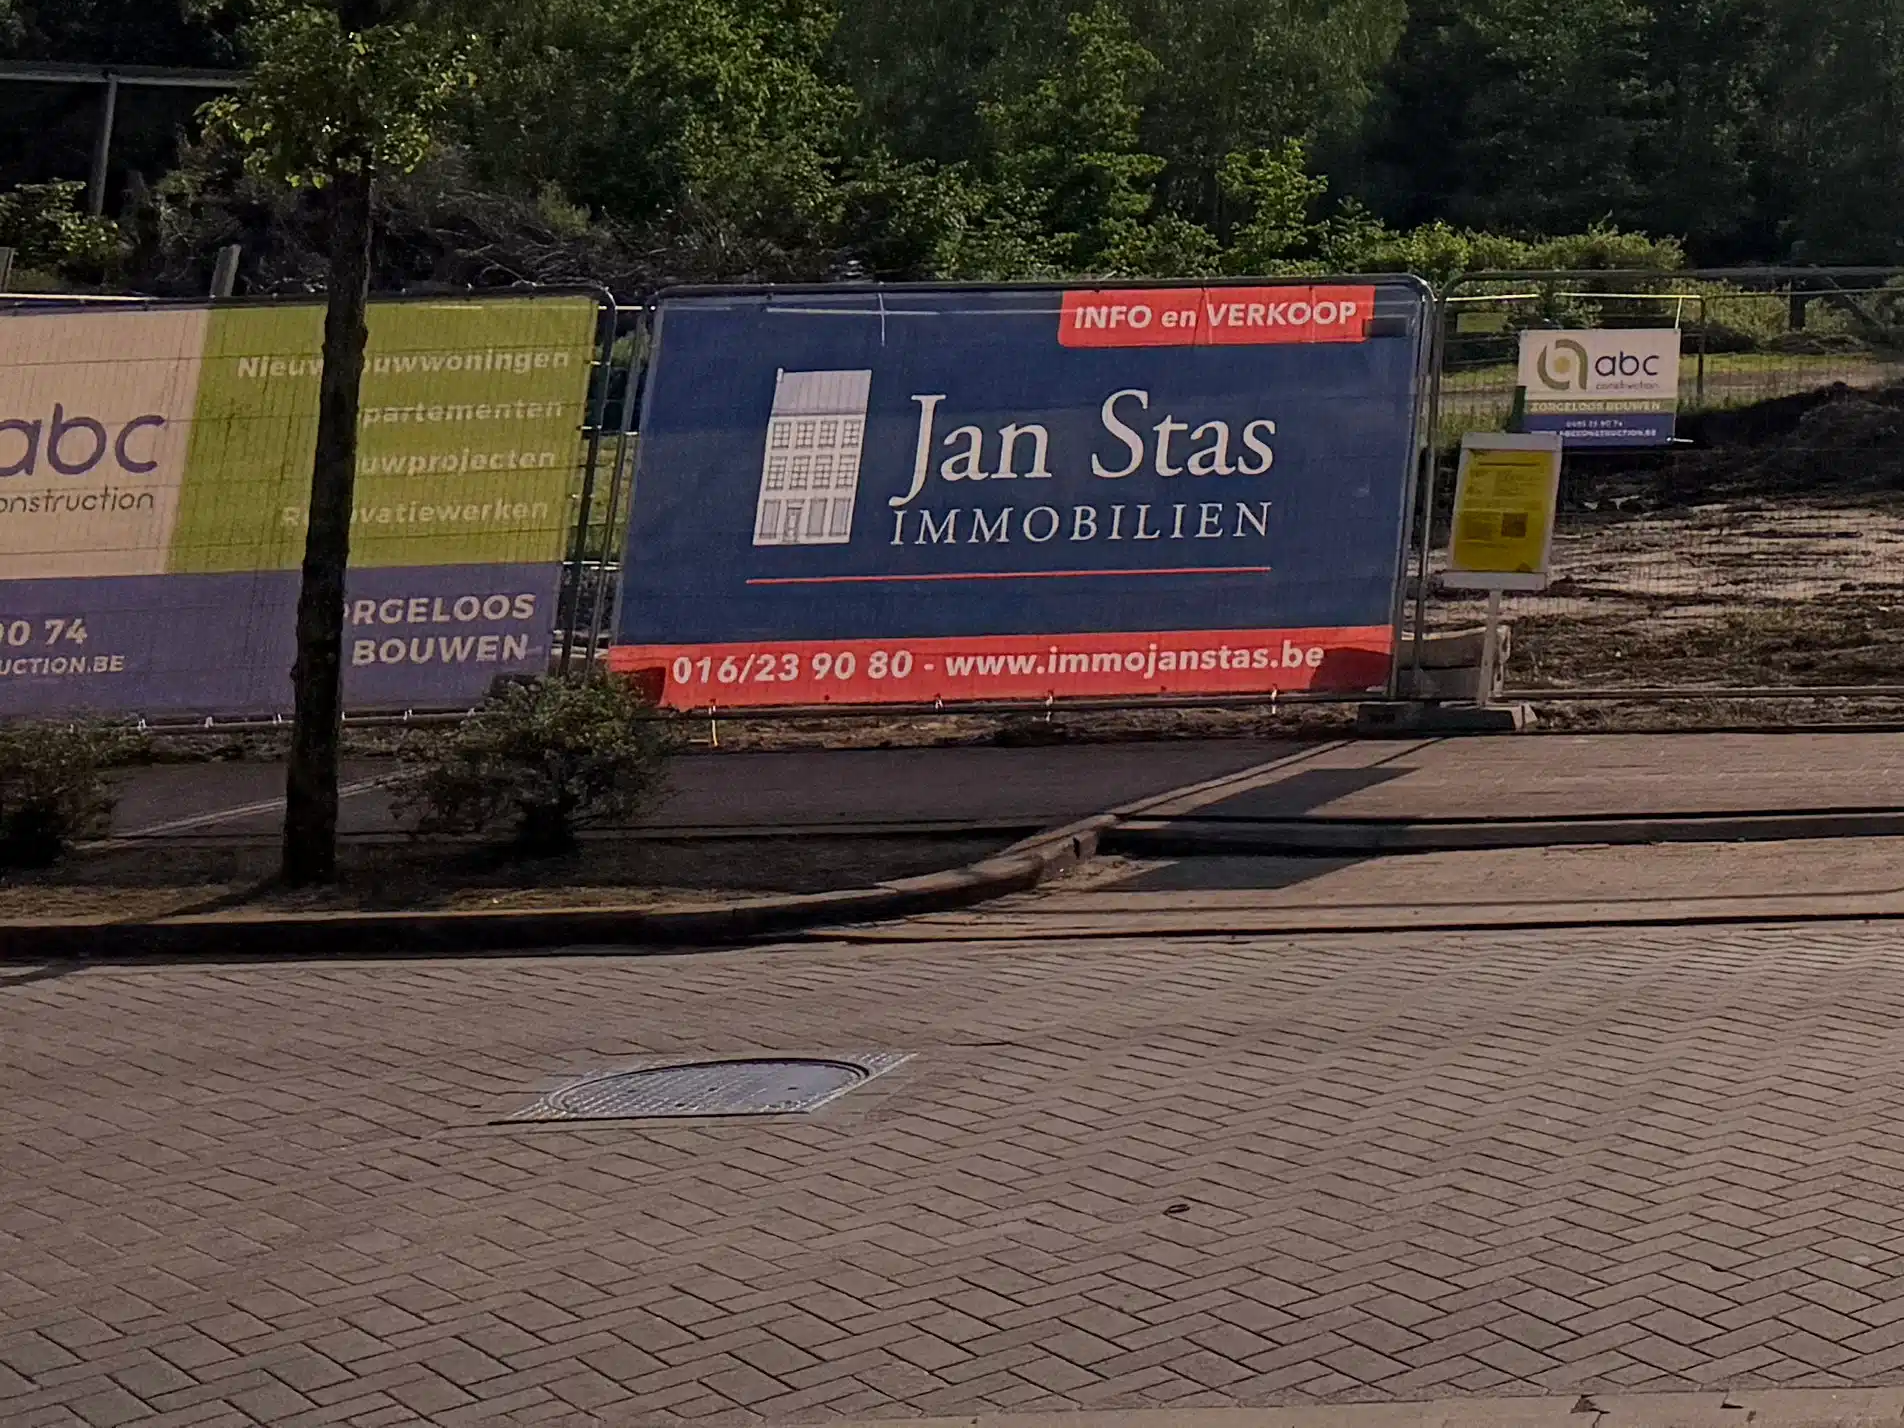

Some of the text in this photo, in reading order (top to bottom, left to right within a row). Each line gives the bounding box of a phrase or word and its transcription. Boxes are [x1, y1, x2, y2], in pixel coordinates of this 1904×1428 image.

[1074, 301, 1356, 329] INFO en VERKOOP
[1595, 350, 1660, 377] abc
[0, 403, 165, 477] abc
[888, 389, 1277, 507] Jan Stas
[890, 501, 1272, 545] IMMOBILIEN
[343, 594, 537, 625] RGELOOS
[45, 618, 88, 644] 74
[351, 633, 528, 666] BOUWEN
[672, 653, 799, 684] 016/23
[811, 652, 856, 681] 90
[868, 650, 913, 679] 80
[945, 640, 1324, 679] www.immojanstas.be
